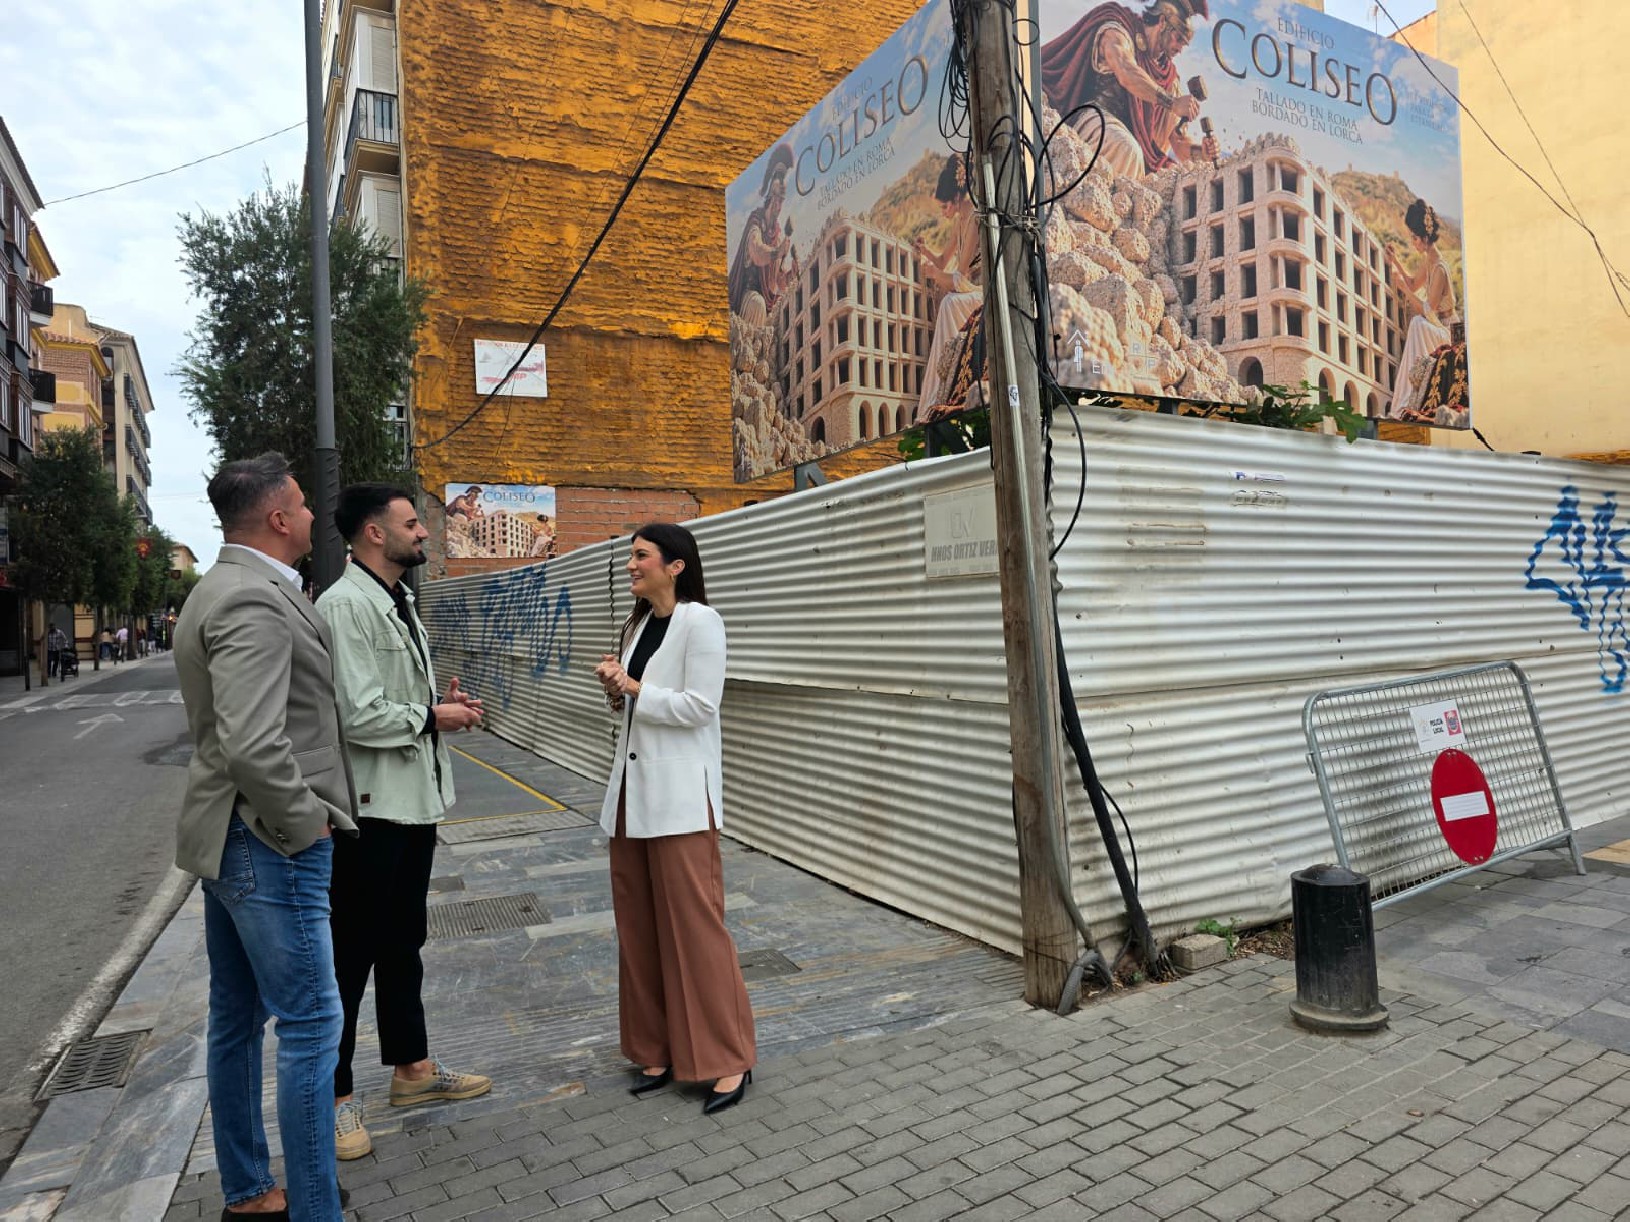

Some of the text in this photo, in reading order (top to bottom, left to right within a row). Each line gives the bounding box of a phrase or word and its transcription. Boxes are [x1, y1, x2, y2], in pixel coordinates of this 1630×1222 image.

[1278, 16, 1335, 49] EDIFICIO
[1212, 18, 1398, 126] COLISEO
[795, 54, 928, 197] COLISEO
[1252, 99, 1363, 144] BORDADO EN LORCA
[1256, 87, 1358, 131] TALLADO EN ROMA
[483, 490, 535, 503] COLISEO
[954, 541, 978, 559] ORTIZ
